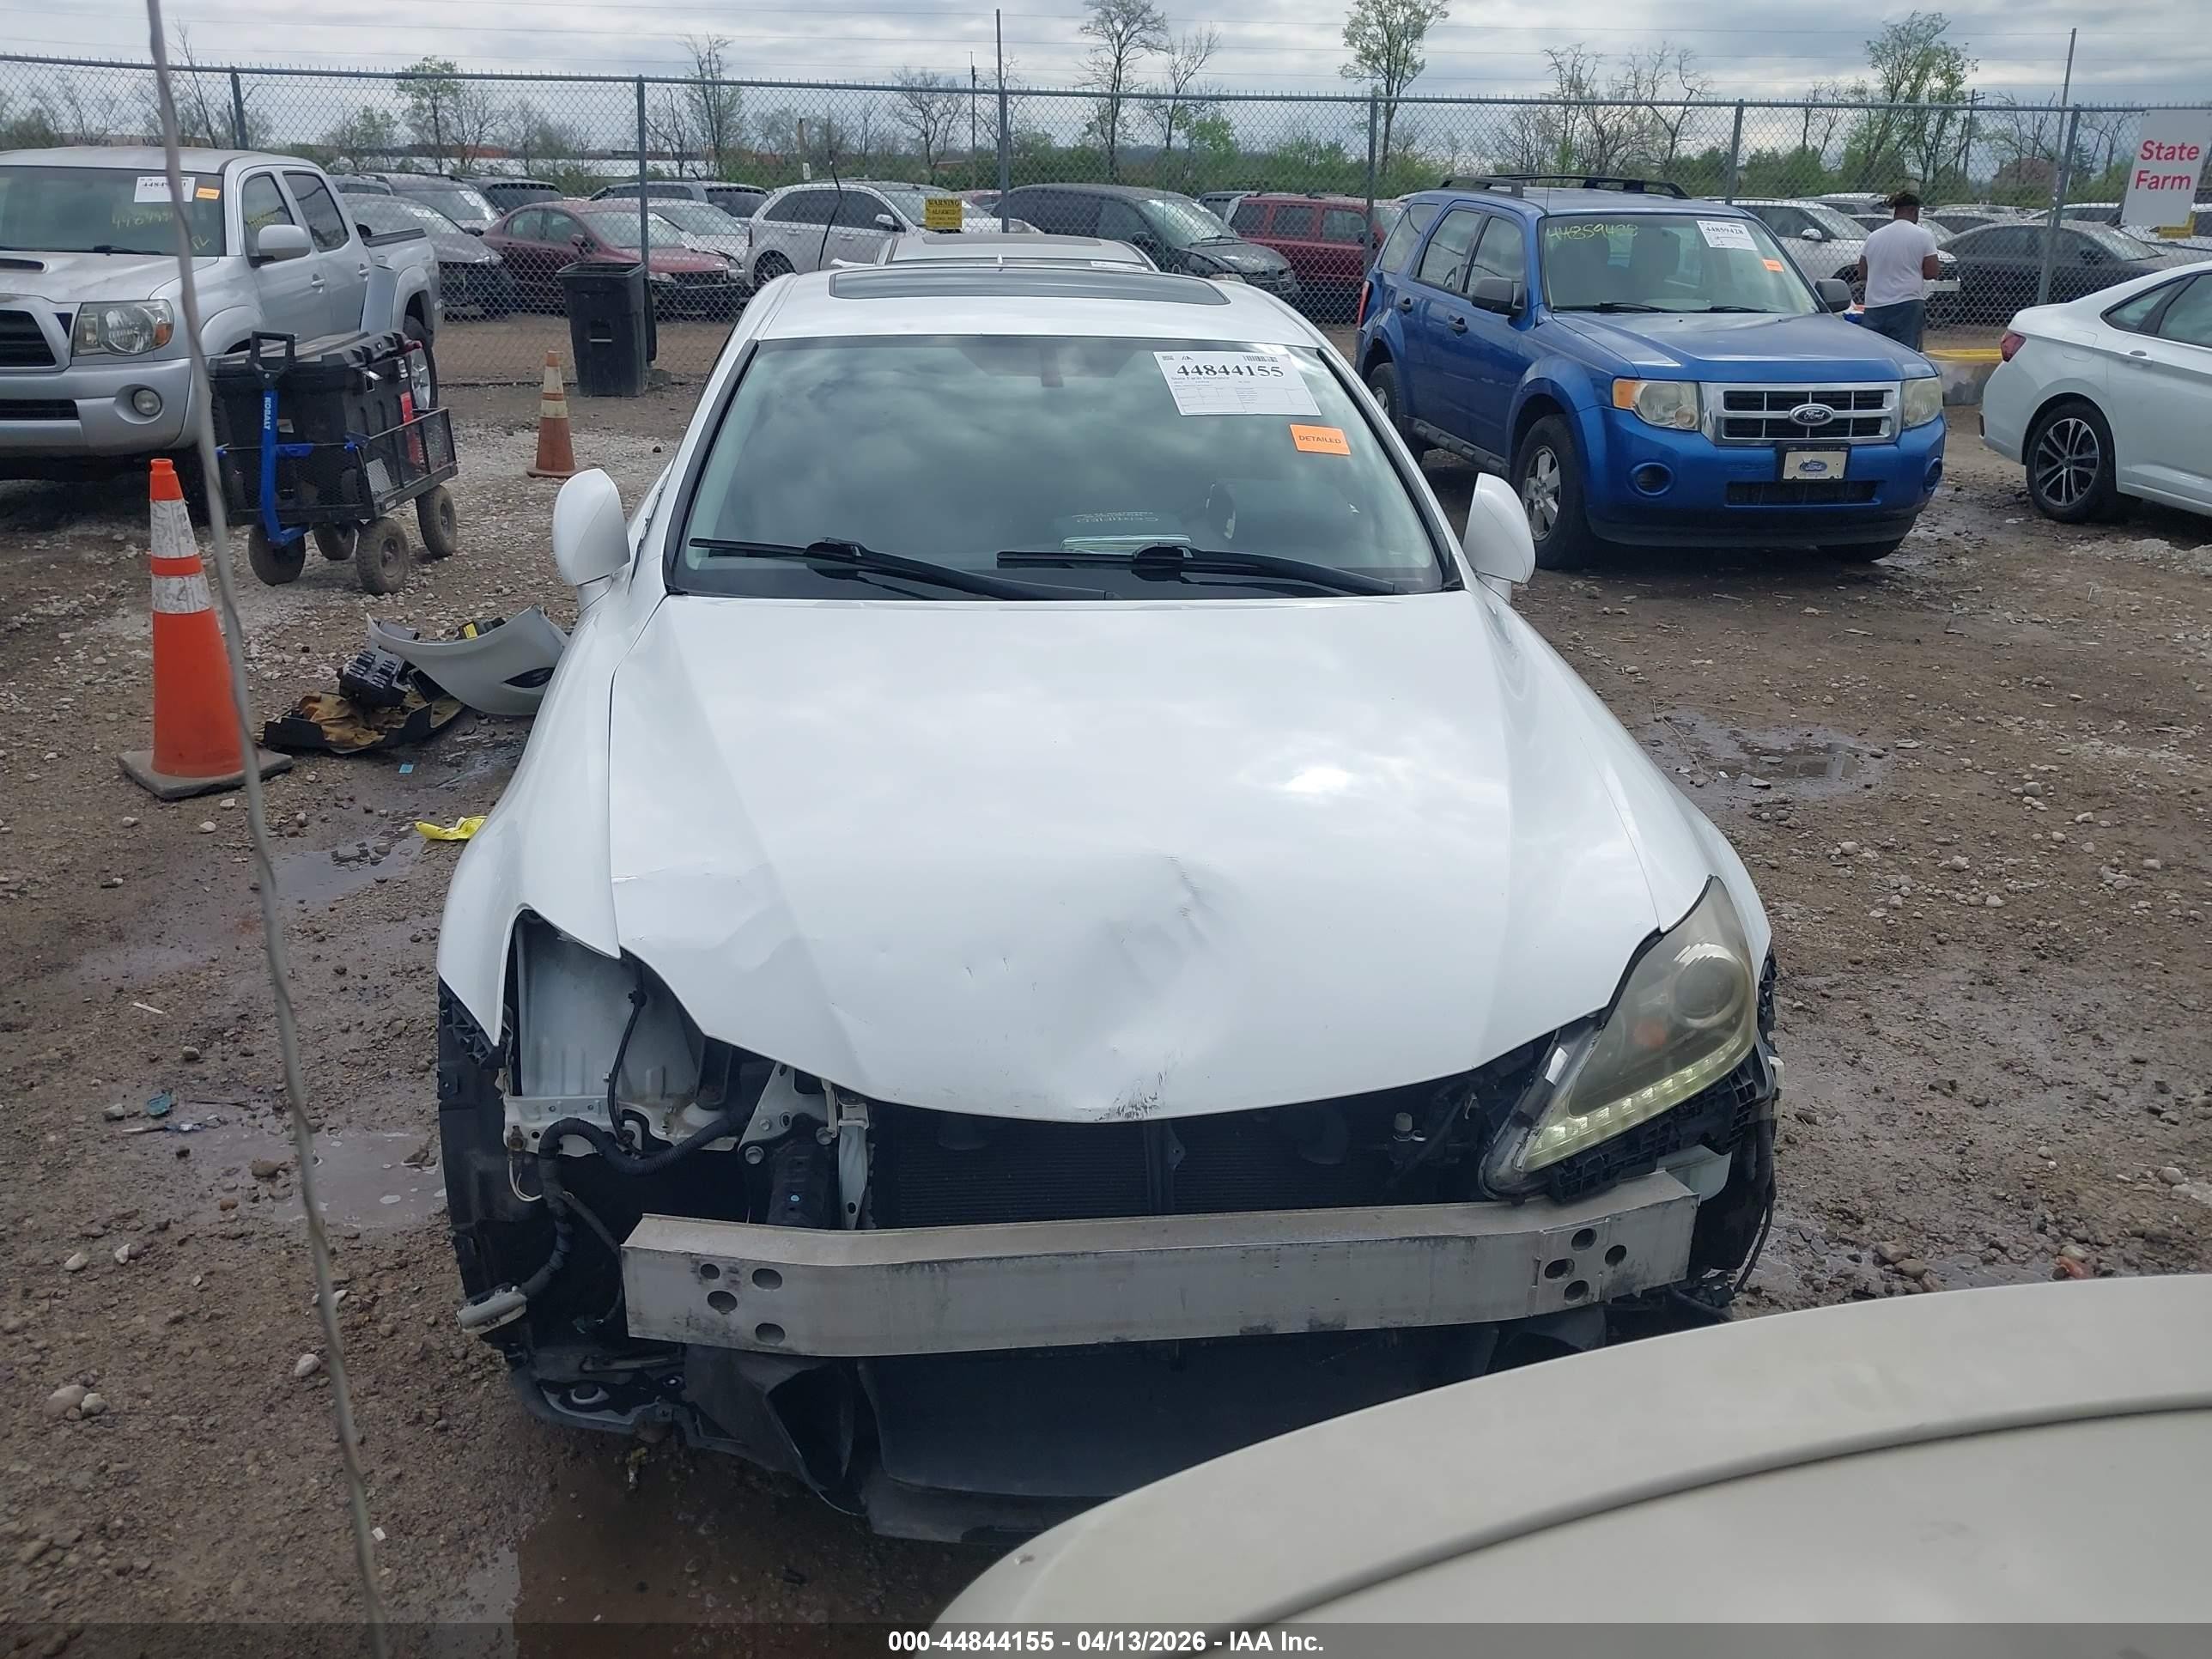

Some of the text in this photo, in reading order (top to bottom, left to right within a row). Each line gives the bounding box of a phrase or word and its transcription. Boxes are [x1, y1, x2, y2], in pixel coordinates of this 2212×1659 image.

[2140, 139, 2200, 161] State
[2135, 170, 2191, 191] Farm
[1705, 226, 1745, 235] 44859428
[1176, 364, 1284, 378] 44844155
[1803, 409, 1826, 420] Ford
[1298, 434, 1341, 445] DETAILED
